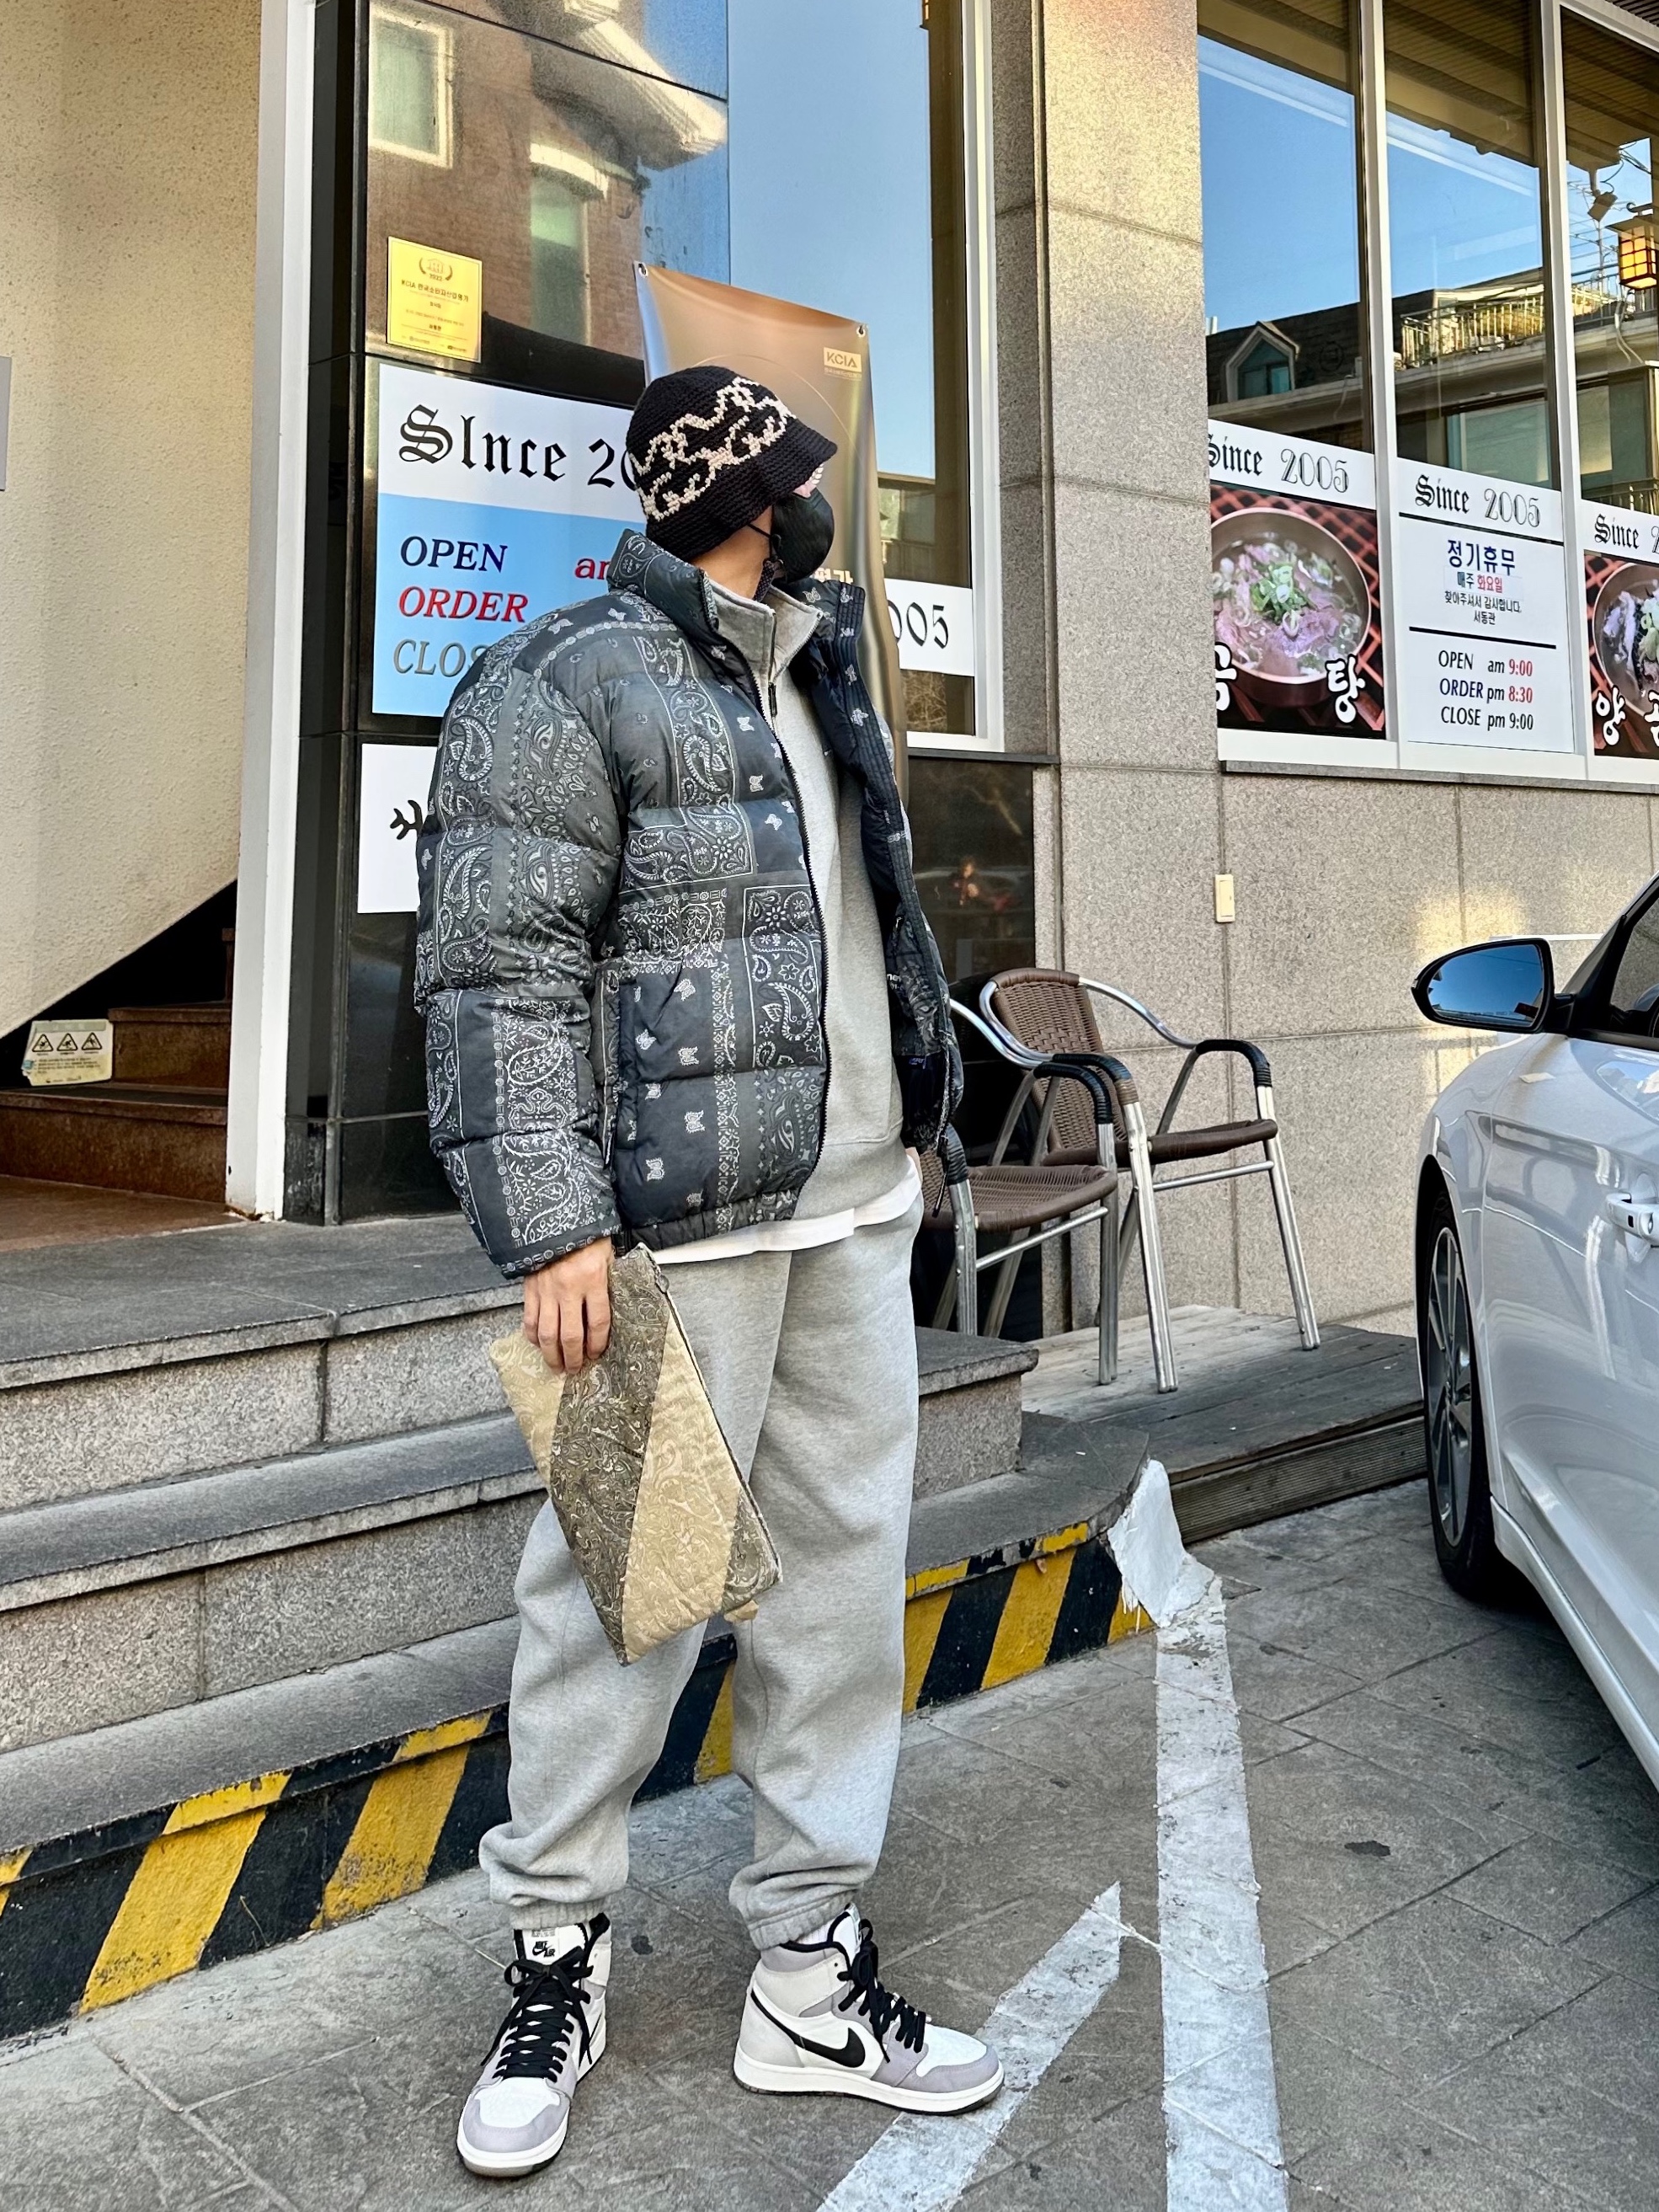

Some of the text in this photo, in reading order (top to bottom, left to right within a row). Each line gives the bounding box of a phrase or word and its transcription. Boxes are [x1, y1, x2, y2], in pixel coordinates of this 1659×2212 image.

[826, 351, 858, 368] KCIA
[1280, 448, 1349, 494] 2005
[1415, 474, 1541, 528] Since 2005
[1594, 513, 1640, 549] Since
[400, 536, 508, 573] OPEN
[1448, 539, 1515, 576] 정기휴무
[1457, 572, 1502, 593] 매주 화요일
[398, 585, 528, 623] ORDER
[1474, 610, 1496, 625] 서동관
[1438, 650, 1533, 676] OPEN am 9:00
[1439, 678, 1533, 704] ORDER pm 8:30
[1441, 706, 1534, 731] CLOSE pm 9:00
